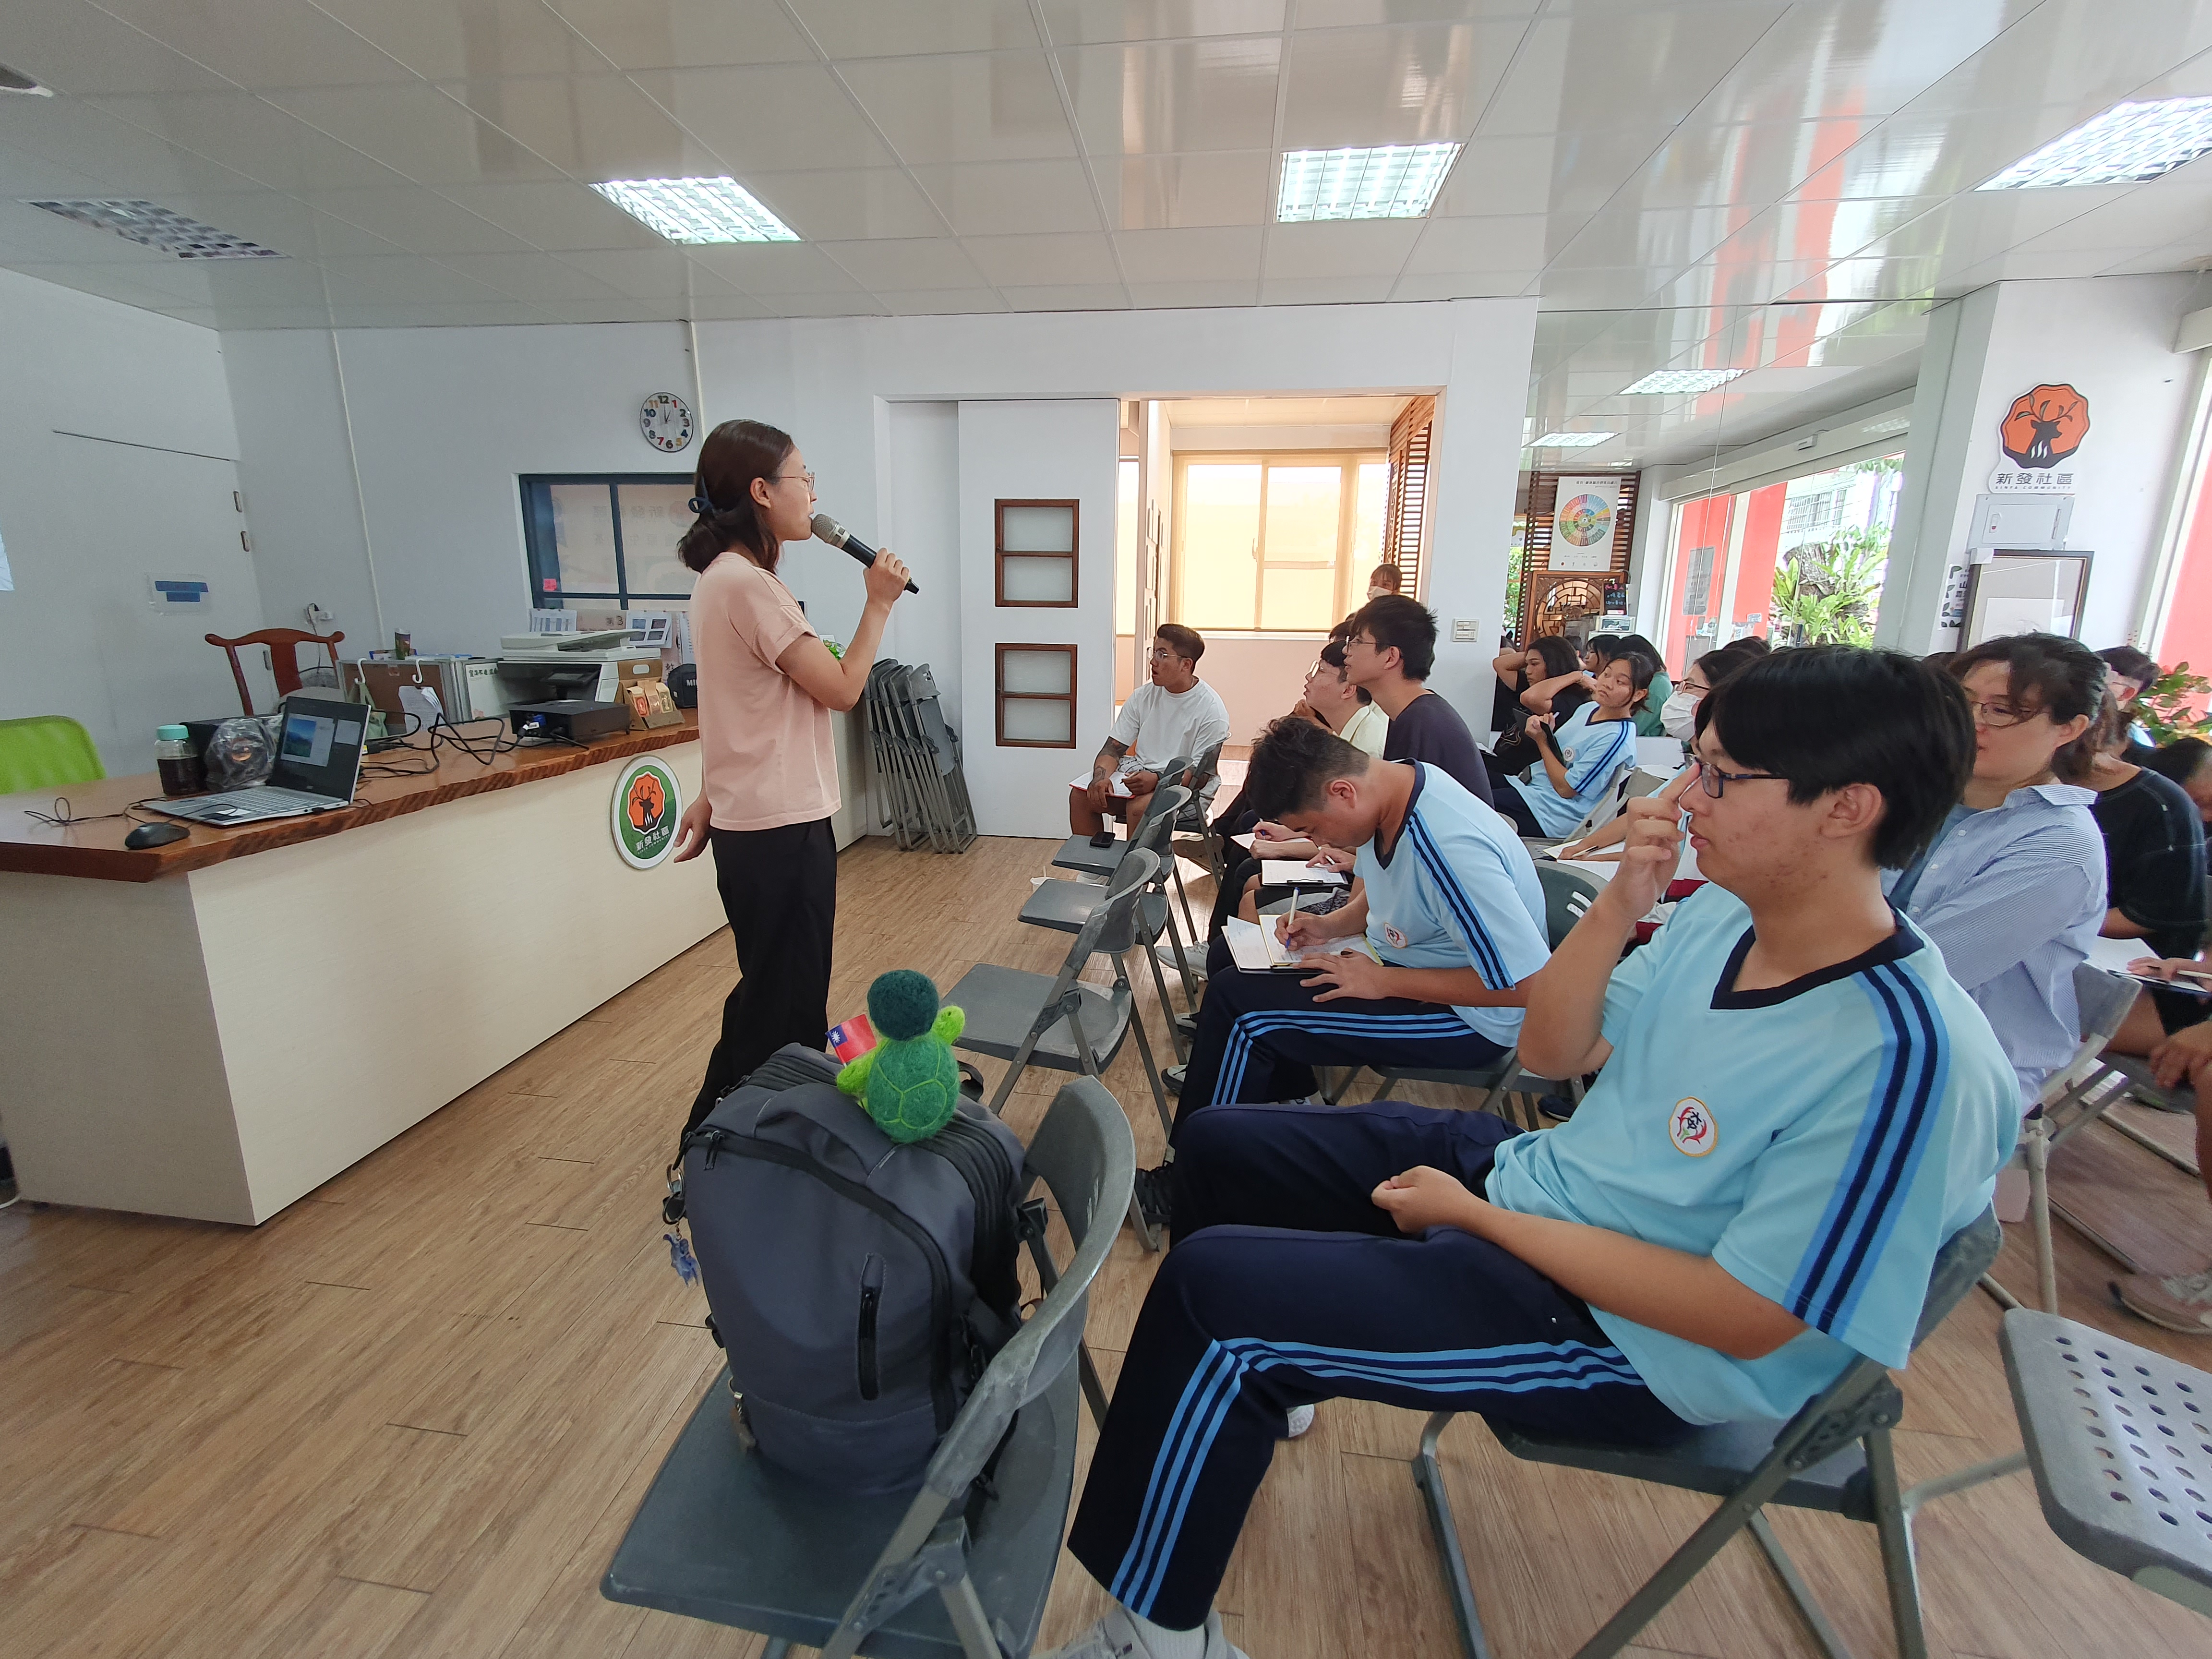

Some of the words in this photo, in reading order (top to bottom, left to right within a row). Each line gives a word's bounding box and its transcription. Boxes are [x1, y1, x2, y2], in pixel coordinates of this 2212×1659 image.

[658, 395, 669, 404] 12
[644, 409, 656, 417] 10
[643, 419, 650, 427] 9
[683, 419, 690, 427] 3
[649, 430, 656, 439] 8
[681, 429, 688, 438] 4
[657, 437, 664, 445] 7
[665, 440, 673, 449] 6
[676, 438, 682, 446] 5
[1995, 473, 2074, 484] 新發社區
[636, 826, 669, 851] 新發社區
